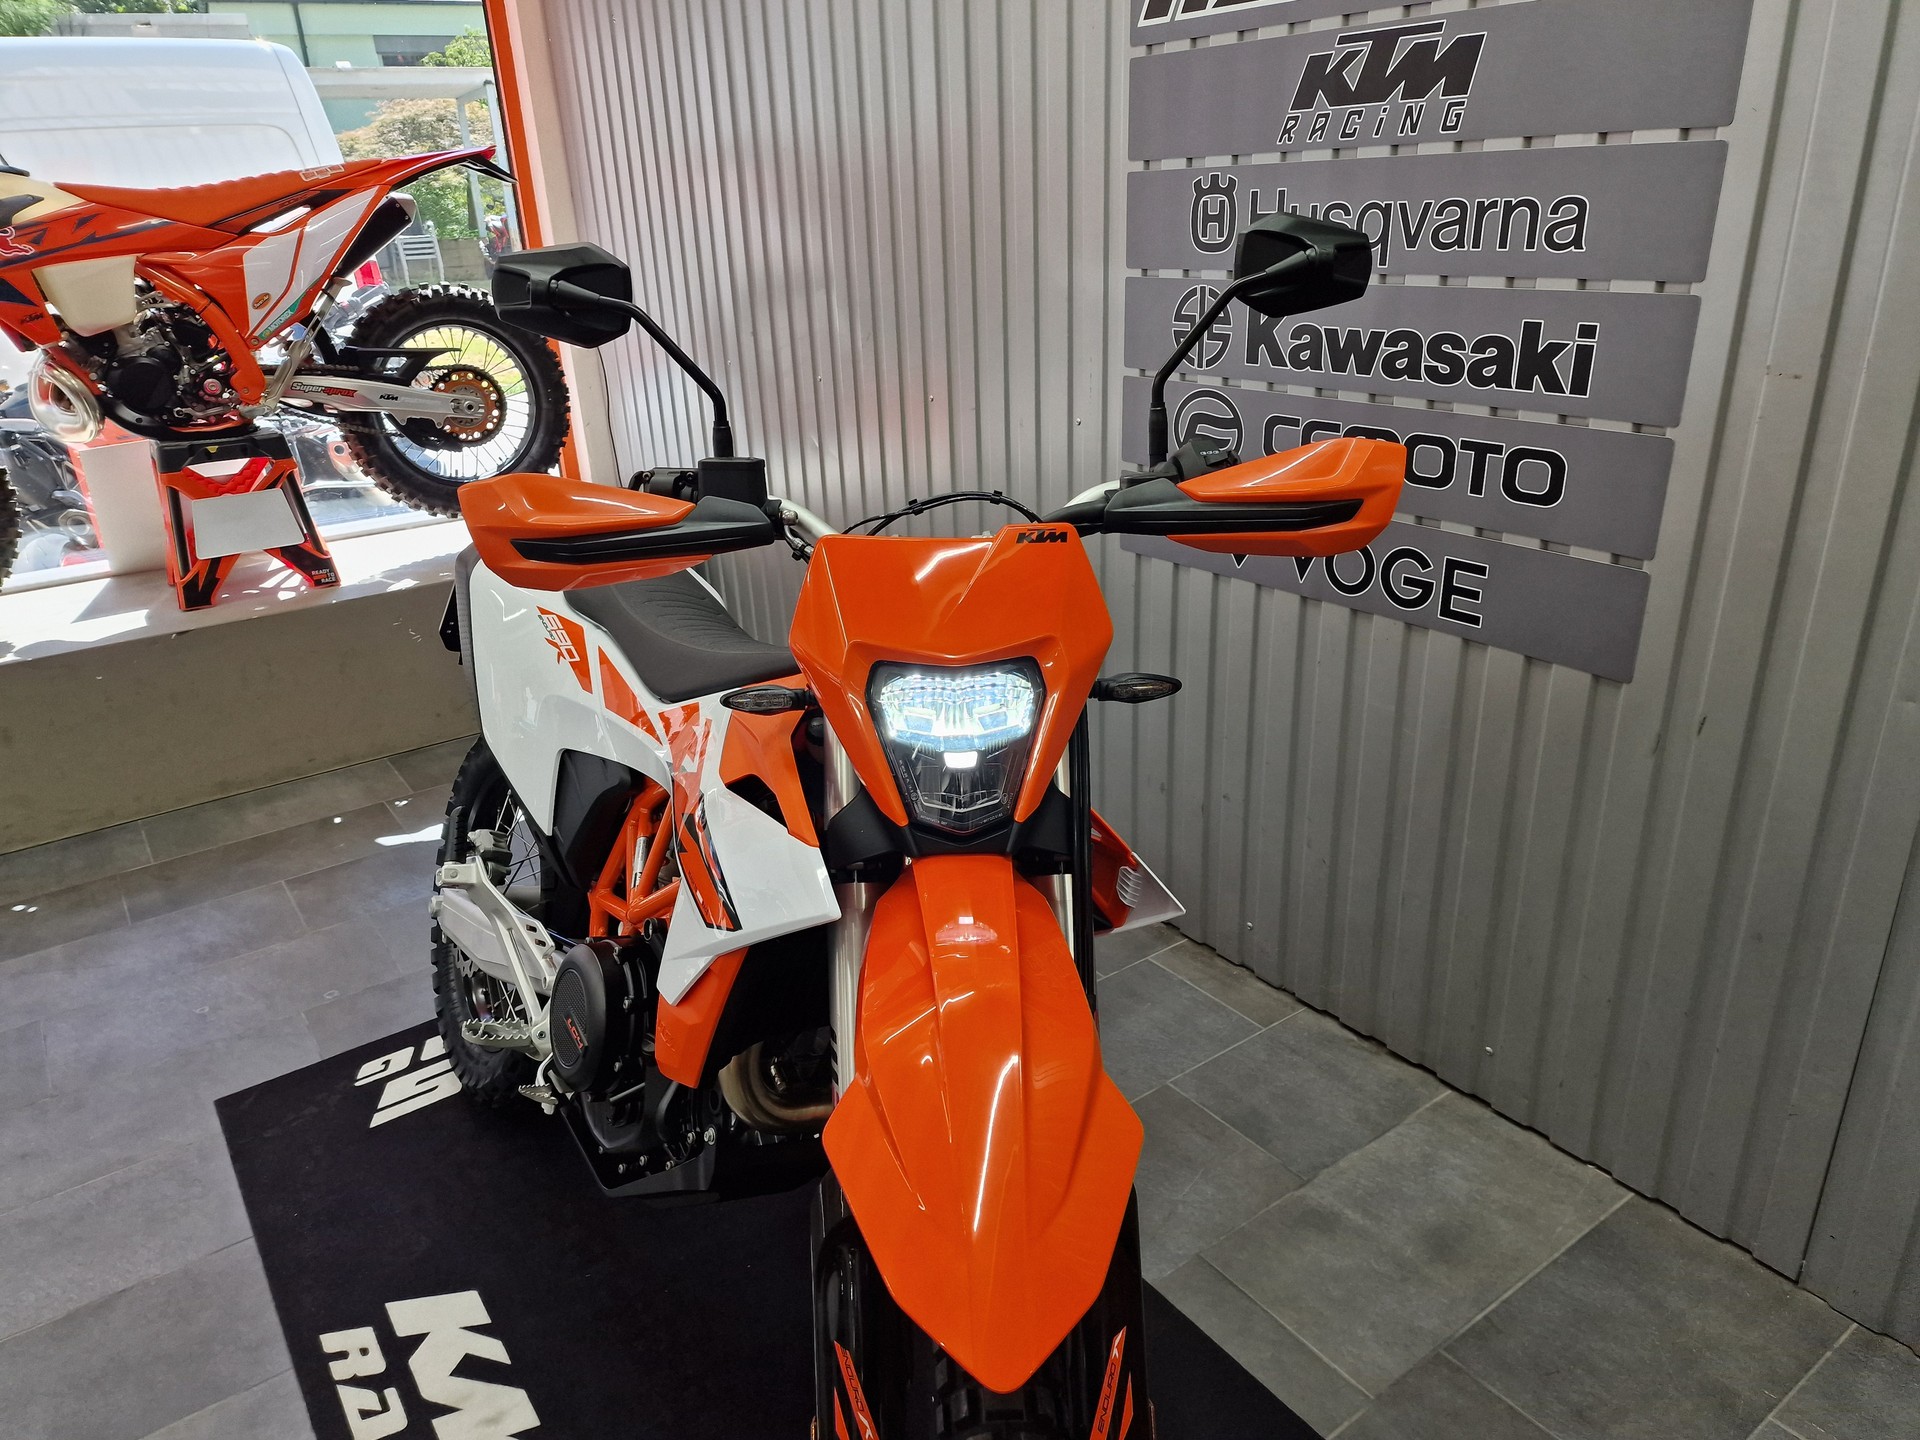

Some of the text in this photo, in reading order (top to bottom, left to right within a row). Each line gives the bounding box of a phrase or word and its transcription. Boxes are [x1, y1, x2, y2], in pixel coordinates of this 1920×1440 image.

[1288, 19, 1488, 113] KTM
[1244, 306, 1600, 398] Kawasaki
[379, 393, 399, 401] KTM
[1016, 528, 1068, 544] KTM
[841, 1346, 865, 1412] ENDURO
[1097, 1362, 1117, 1434] ENDURO
